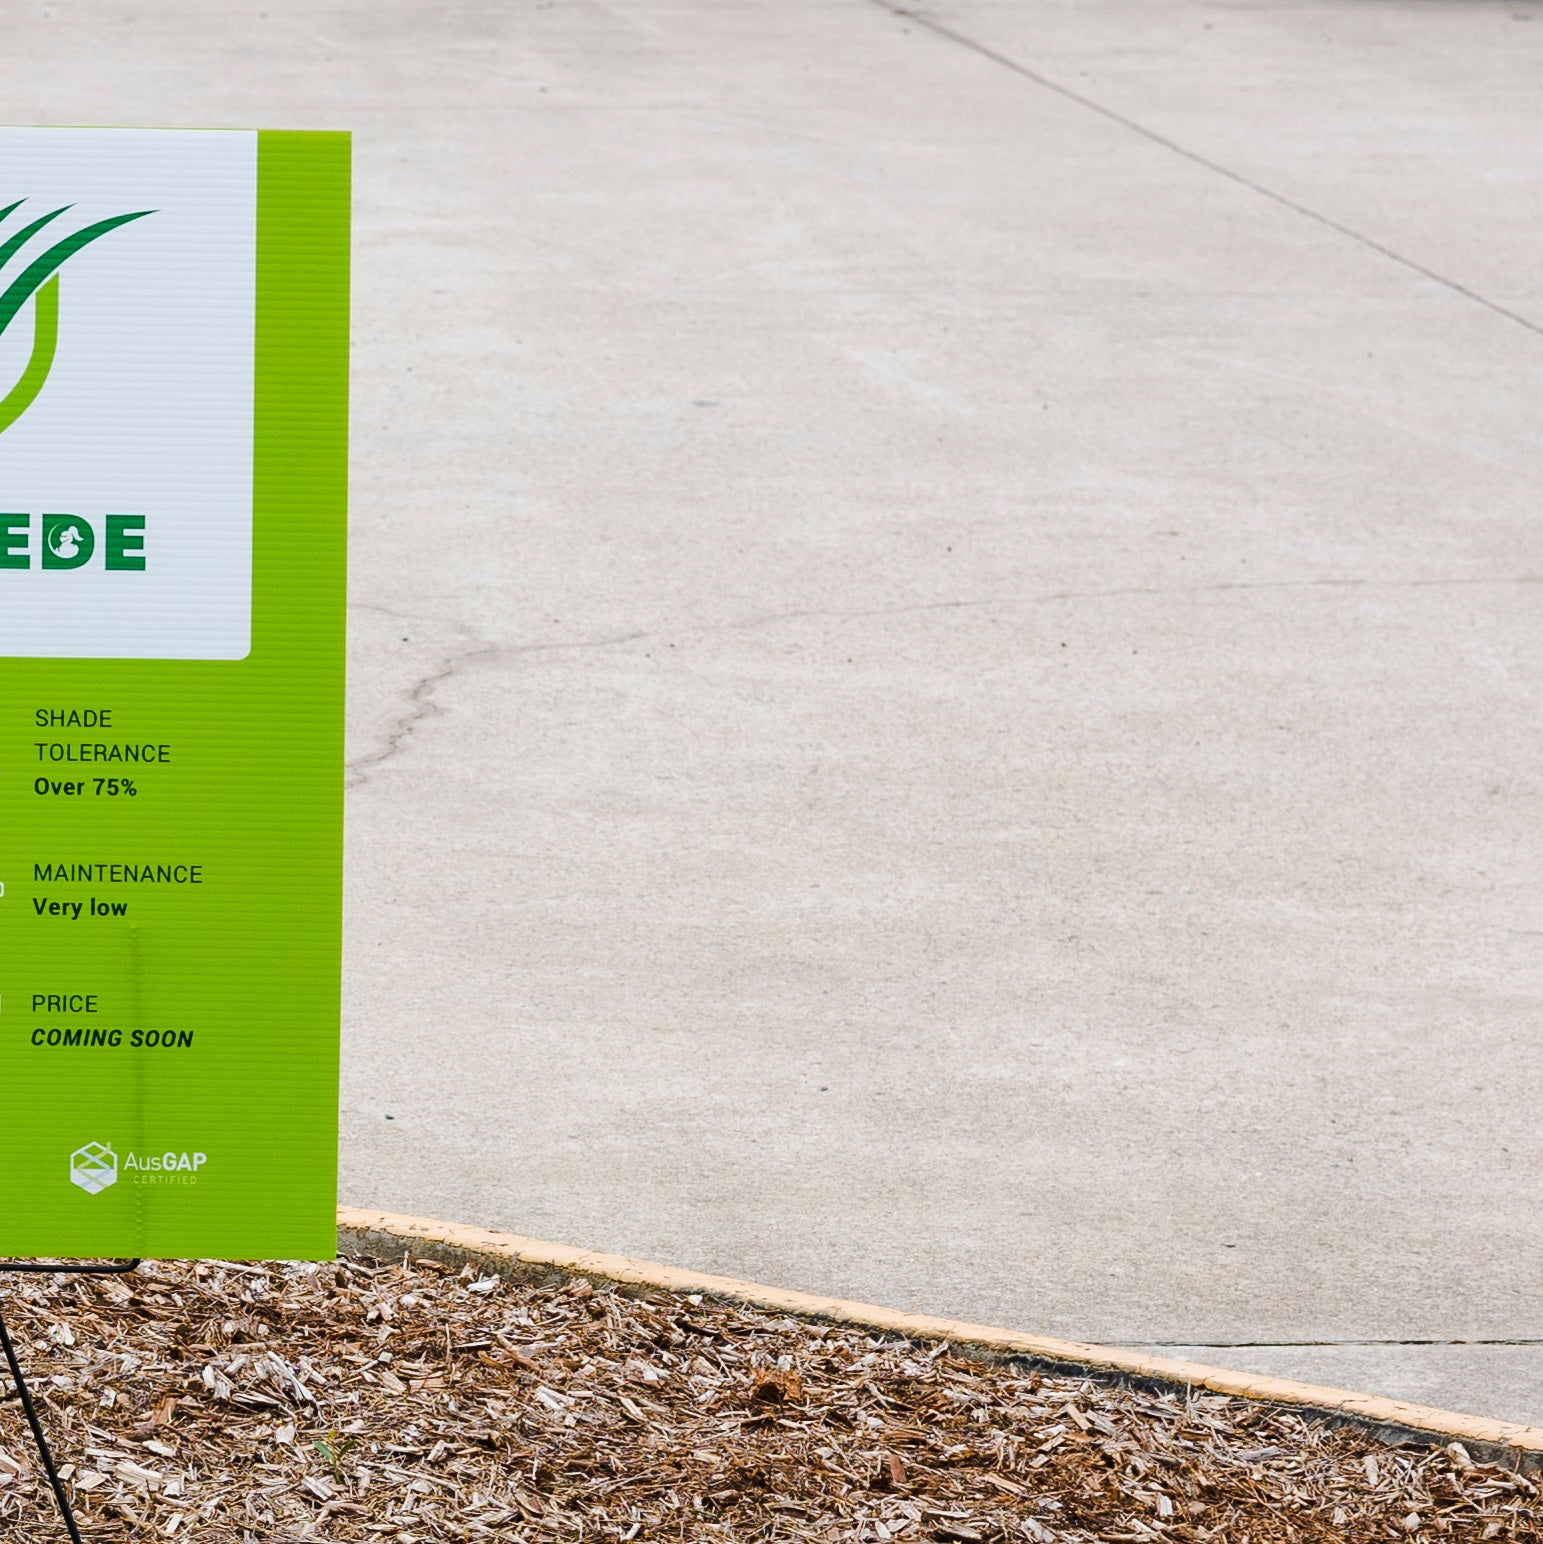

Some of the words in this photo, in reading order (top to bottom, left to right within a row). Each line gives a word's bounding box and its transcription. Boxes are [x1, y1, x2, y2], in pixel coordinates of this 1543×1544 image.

[35, 708, 113, 728] SHADE
[34, 742, 171, 763] TOLERANCE
[34, 777, 85, 796] Over
[92, 777, 138, 797] 75%
[34, 863, 203, 884] MAINTENANCE
[32, 897, 83, 921] Very
[90, 896, 128, 917] low
[32, 994, 98, 1013] PRICE
[30, 1028, 123, 1048] COMING
[129, 1029, 194, 1048] SOON
[123, 1151, 207, 1171] AusGAP
[133, 1175, 197, 1185] CERTIFIED
